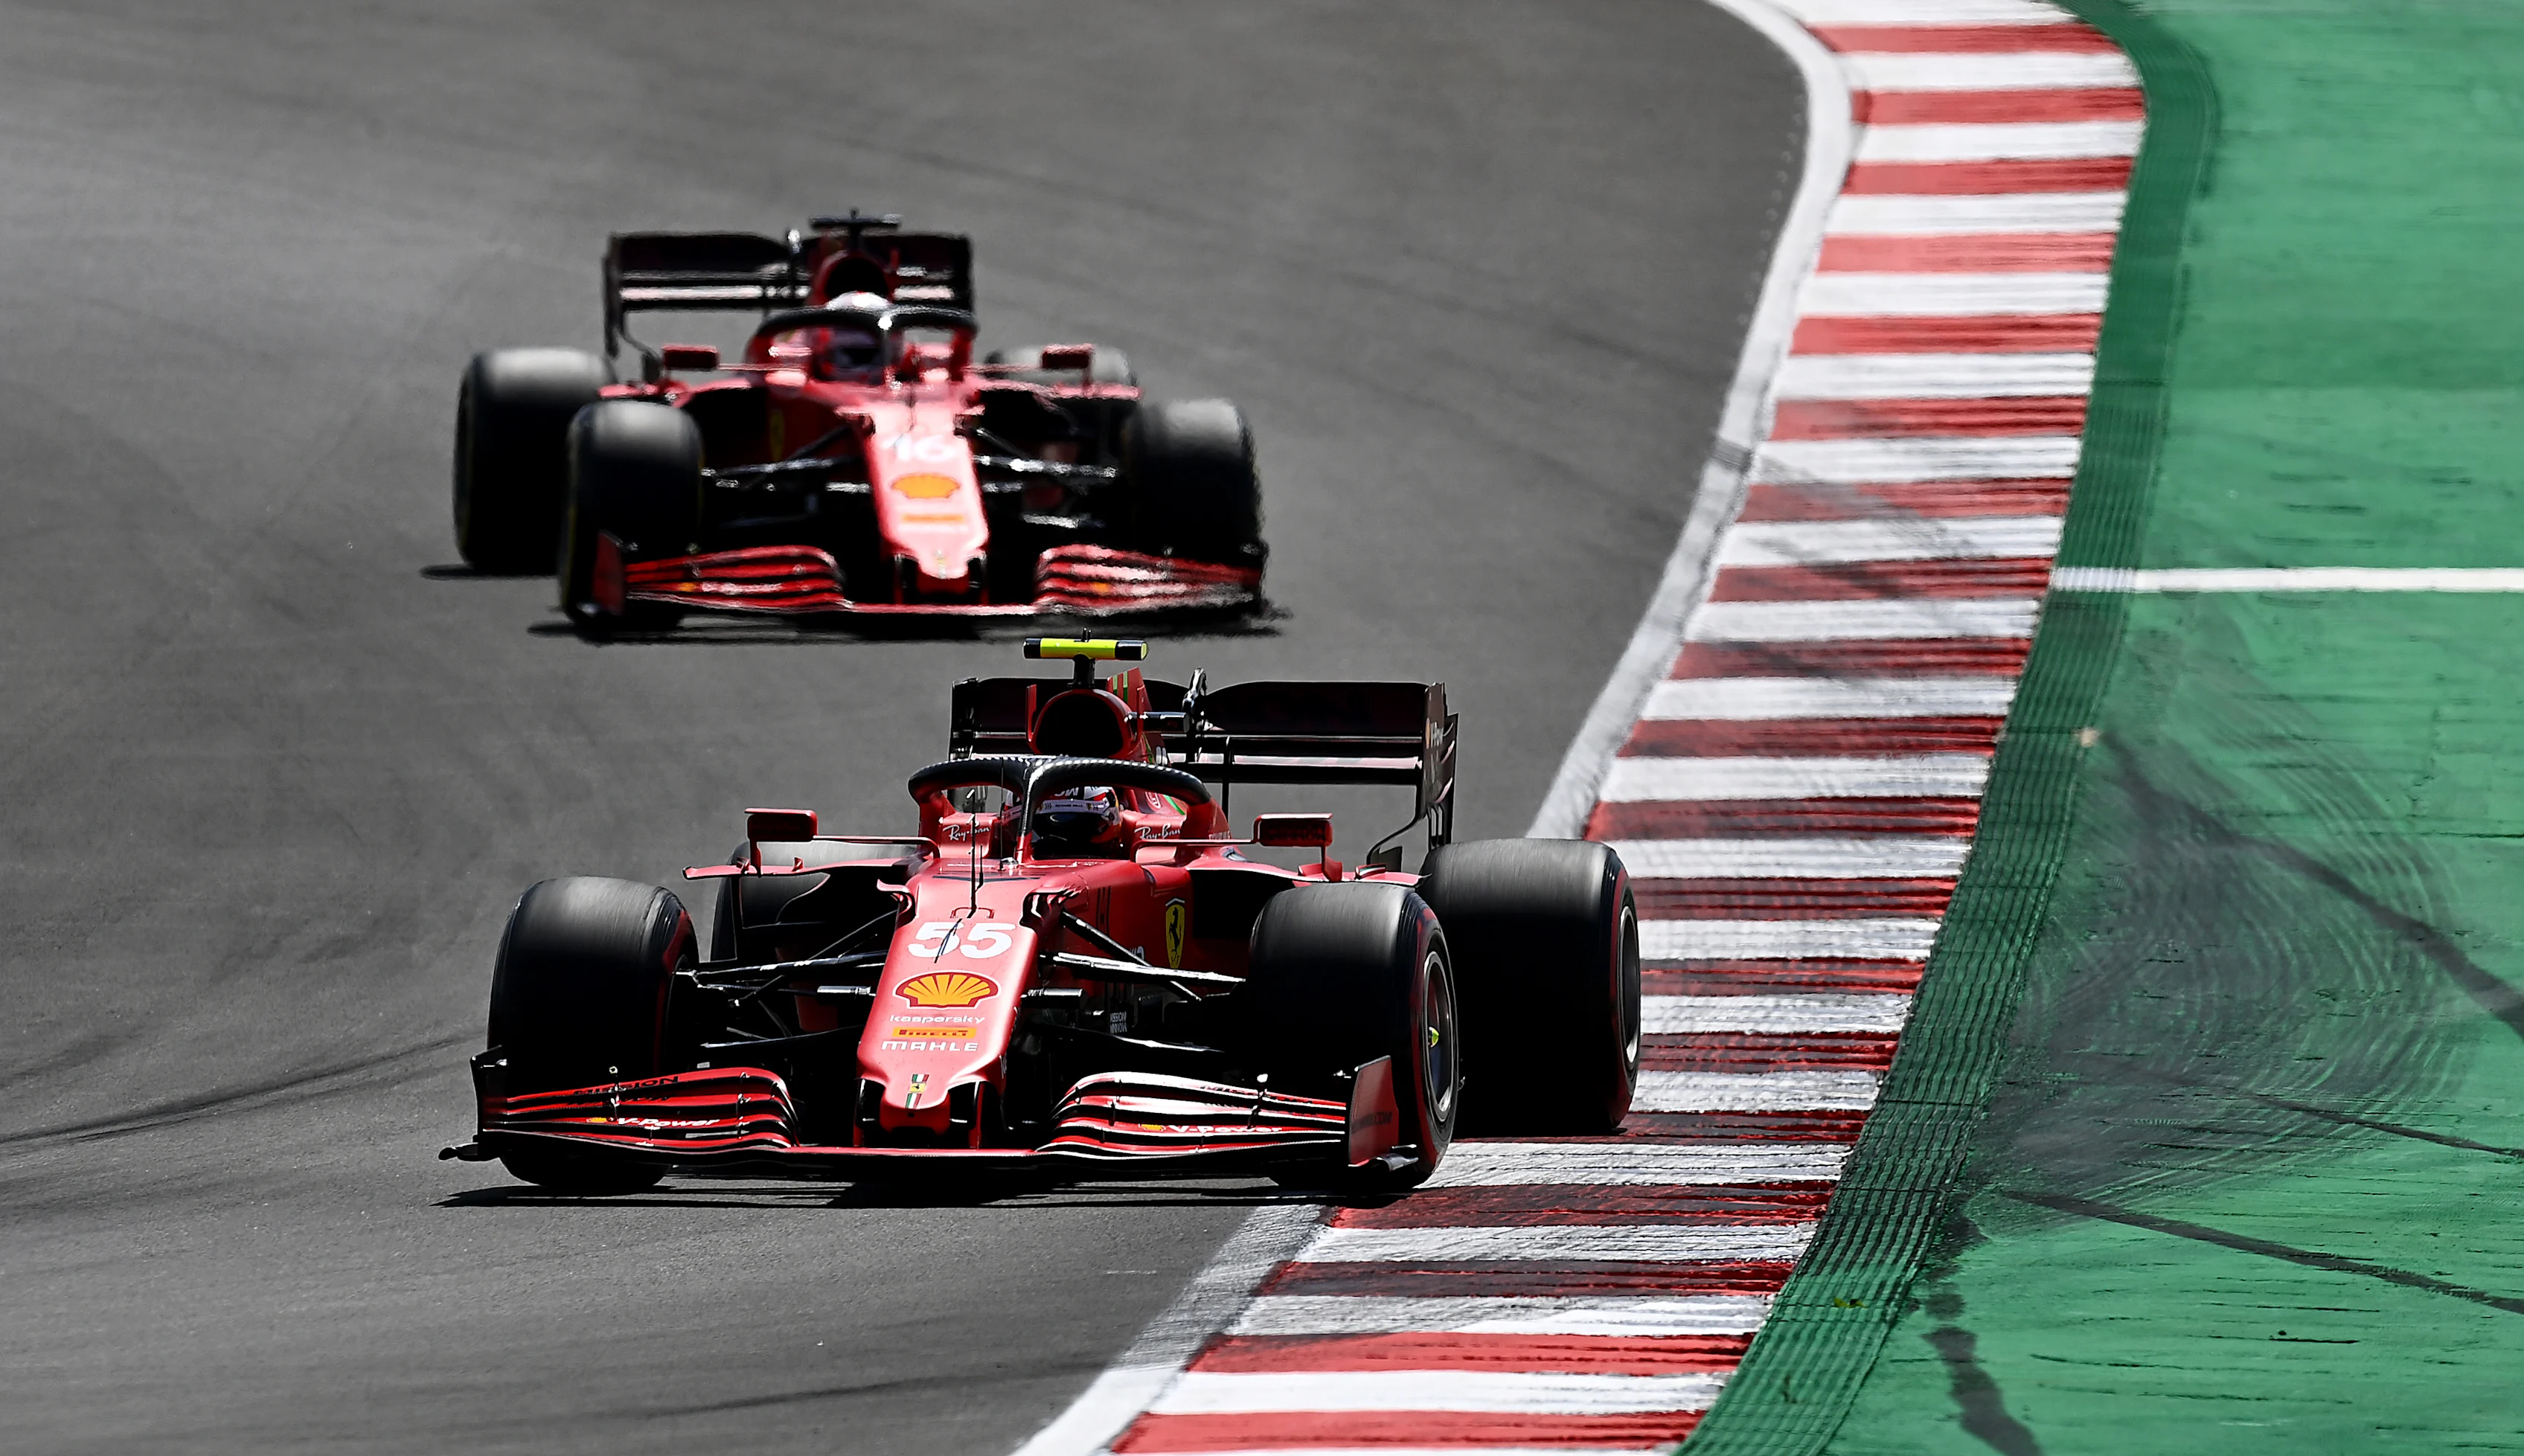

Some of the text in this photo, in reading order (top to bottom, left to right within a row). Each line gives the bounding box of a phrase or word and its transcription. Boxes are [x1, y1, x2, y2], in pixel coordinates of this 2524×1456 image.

[880, 434, 958, 462] 16
[908, 922, 1016, 959] 55
[881, 1040, 978, 1051] MAHLE
[618, 1117, 720, 1127] V-Power
[1169, 1124, 1283, 1133] V-Power
